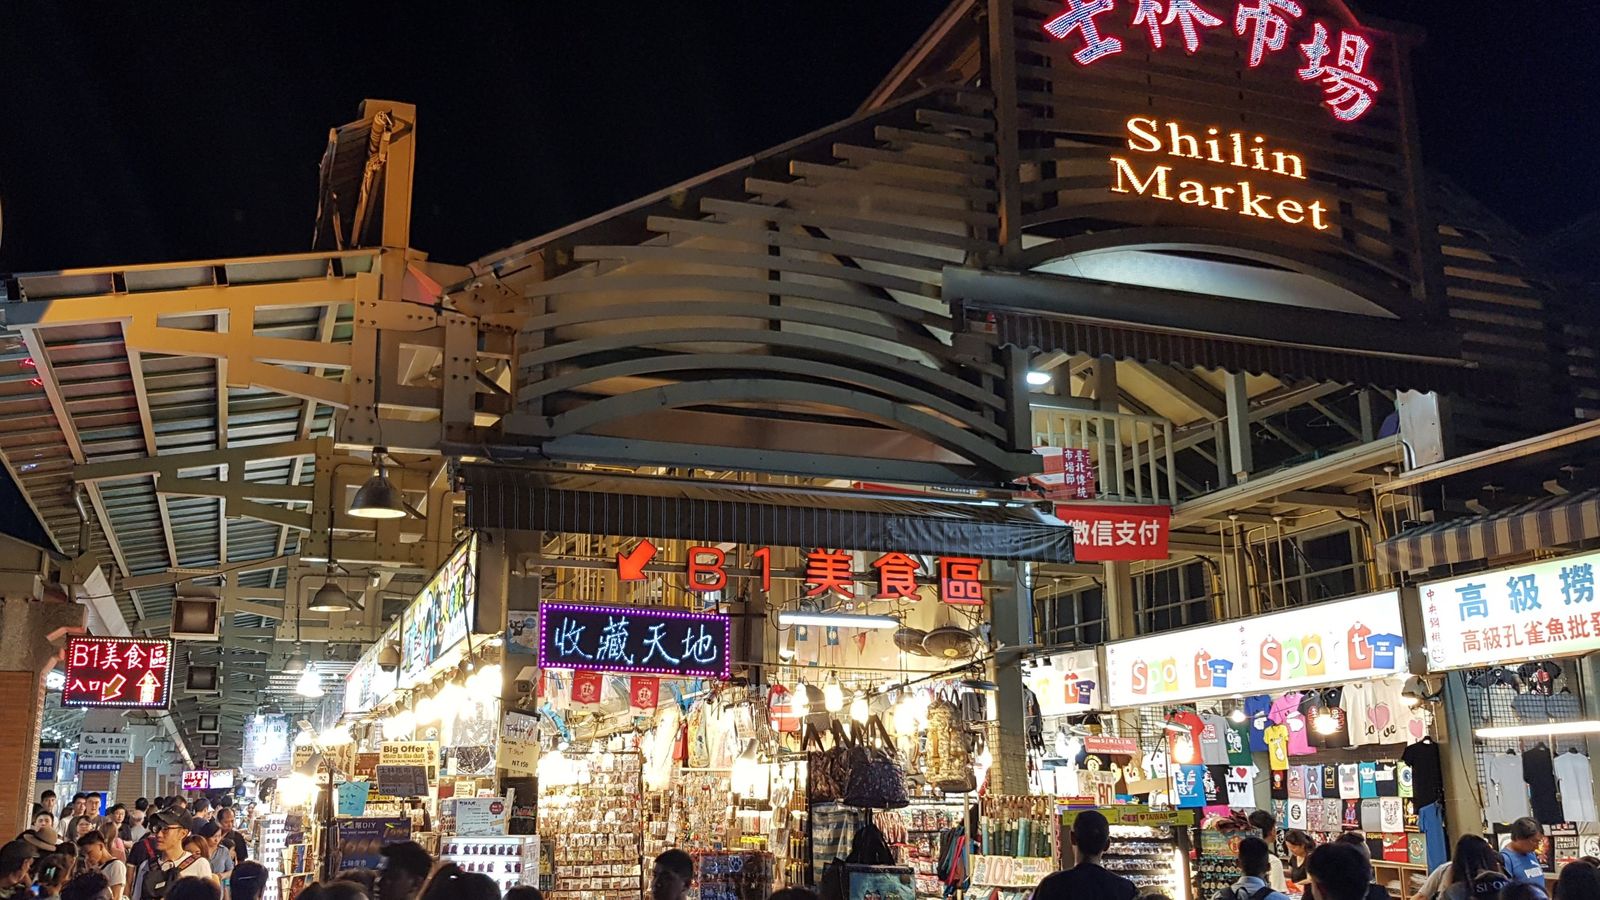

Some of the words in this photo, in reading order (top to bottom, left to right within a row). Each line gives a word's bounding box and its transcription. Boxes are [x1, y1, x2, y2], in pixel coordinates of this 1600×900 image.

[1044, 0, 1378, 121] 士林市場
[1126, 117, 1307, 180] Shilin
[1109, 156, 1329, 231] Market
[1069, 519, 1160, 547] 微信支付
[553, 614, 718, 665] 收藏天地
[72, 642, 168, 671] B1美食區
[70, 678, 100, 692] 入口
[383, 745, 399, 754] Big
[400, 745, 425, 753] Offer
[1228, 781, 1248, 793] TW
[1145, 813, 1168, 821] TAIWAN
